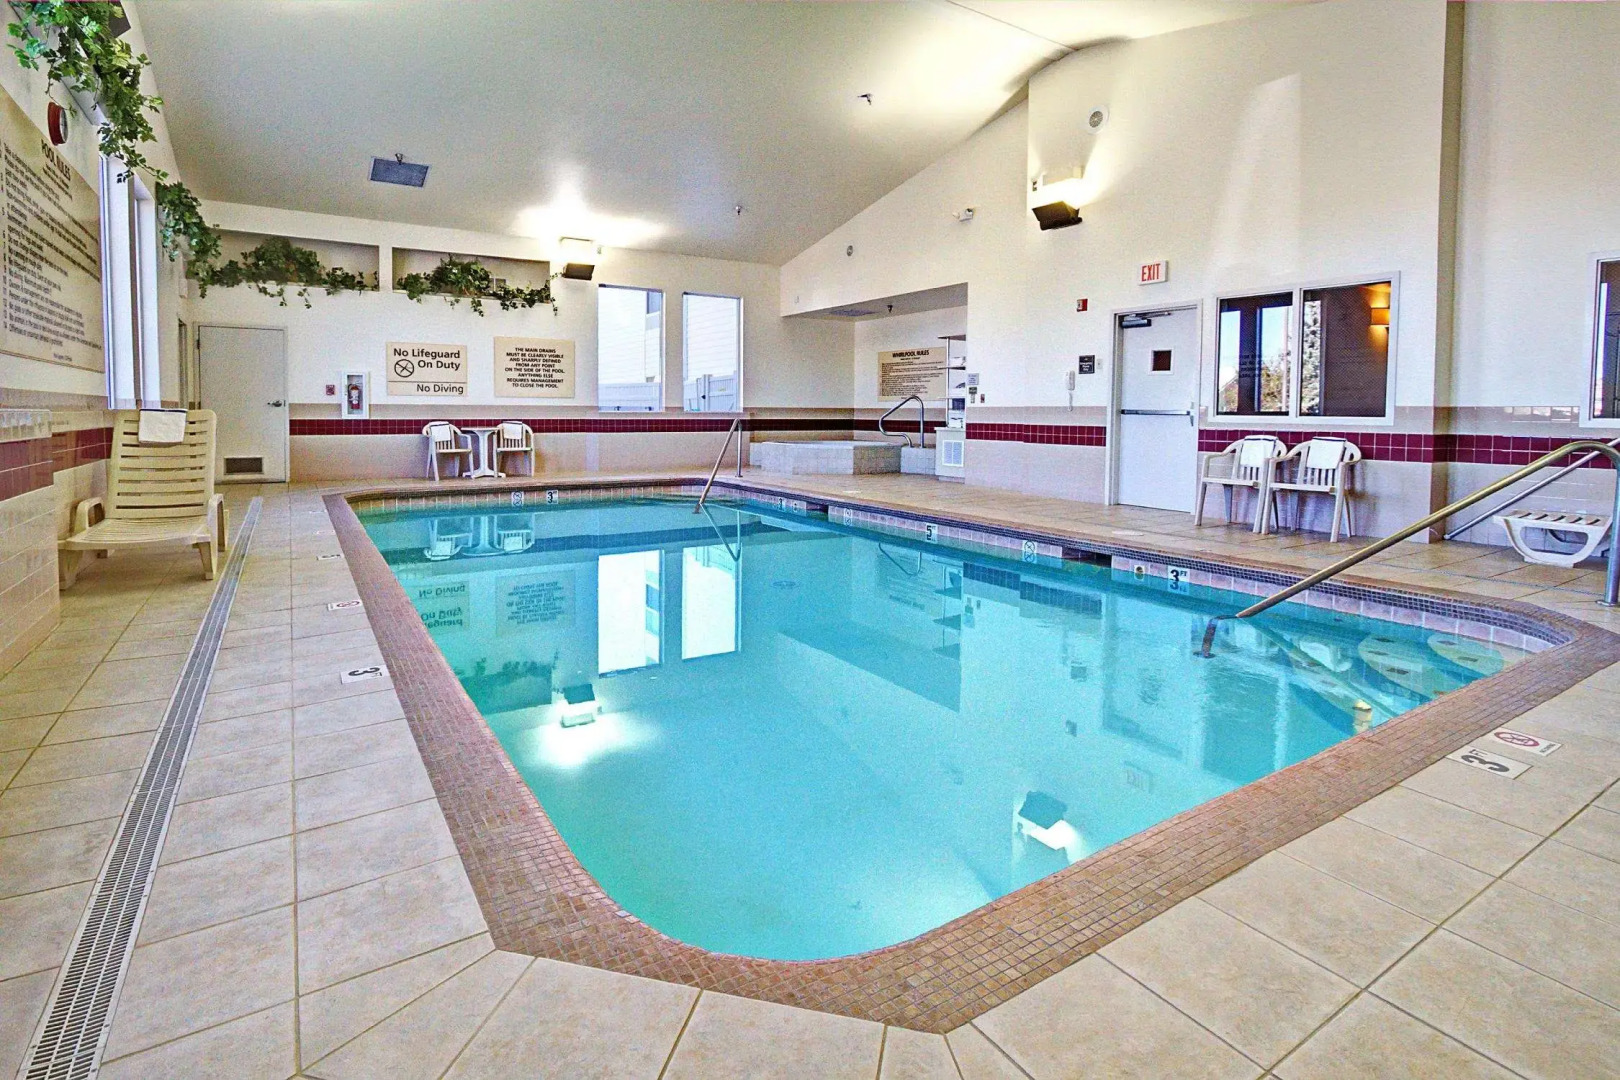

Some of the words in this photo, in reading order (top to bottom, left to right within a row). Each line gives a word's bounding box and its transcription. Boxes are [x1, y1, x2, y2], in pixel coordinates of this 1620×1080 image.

[41, 138, 56, 167] POOL
[1142, 263, 1161, 282] EXIT
[394, 348, 409, 357] No
[412, 349, 460, 359] Lifeguard
[418, 360, 433, 368] On
[436, 360, 461, 371] Duty
[416, 384, 430, 392] No
[434, 384, 464, 395] Diving
[1170, 570, 1180, 582] 3
[348, 667, 380, 676] 3
[1461, 754, 1510, 773] 3
